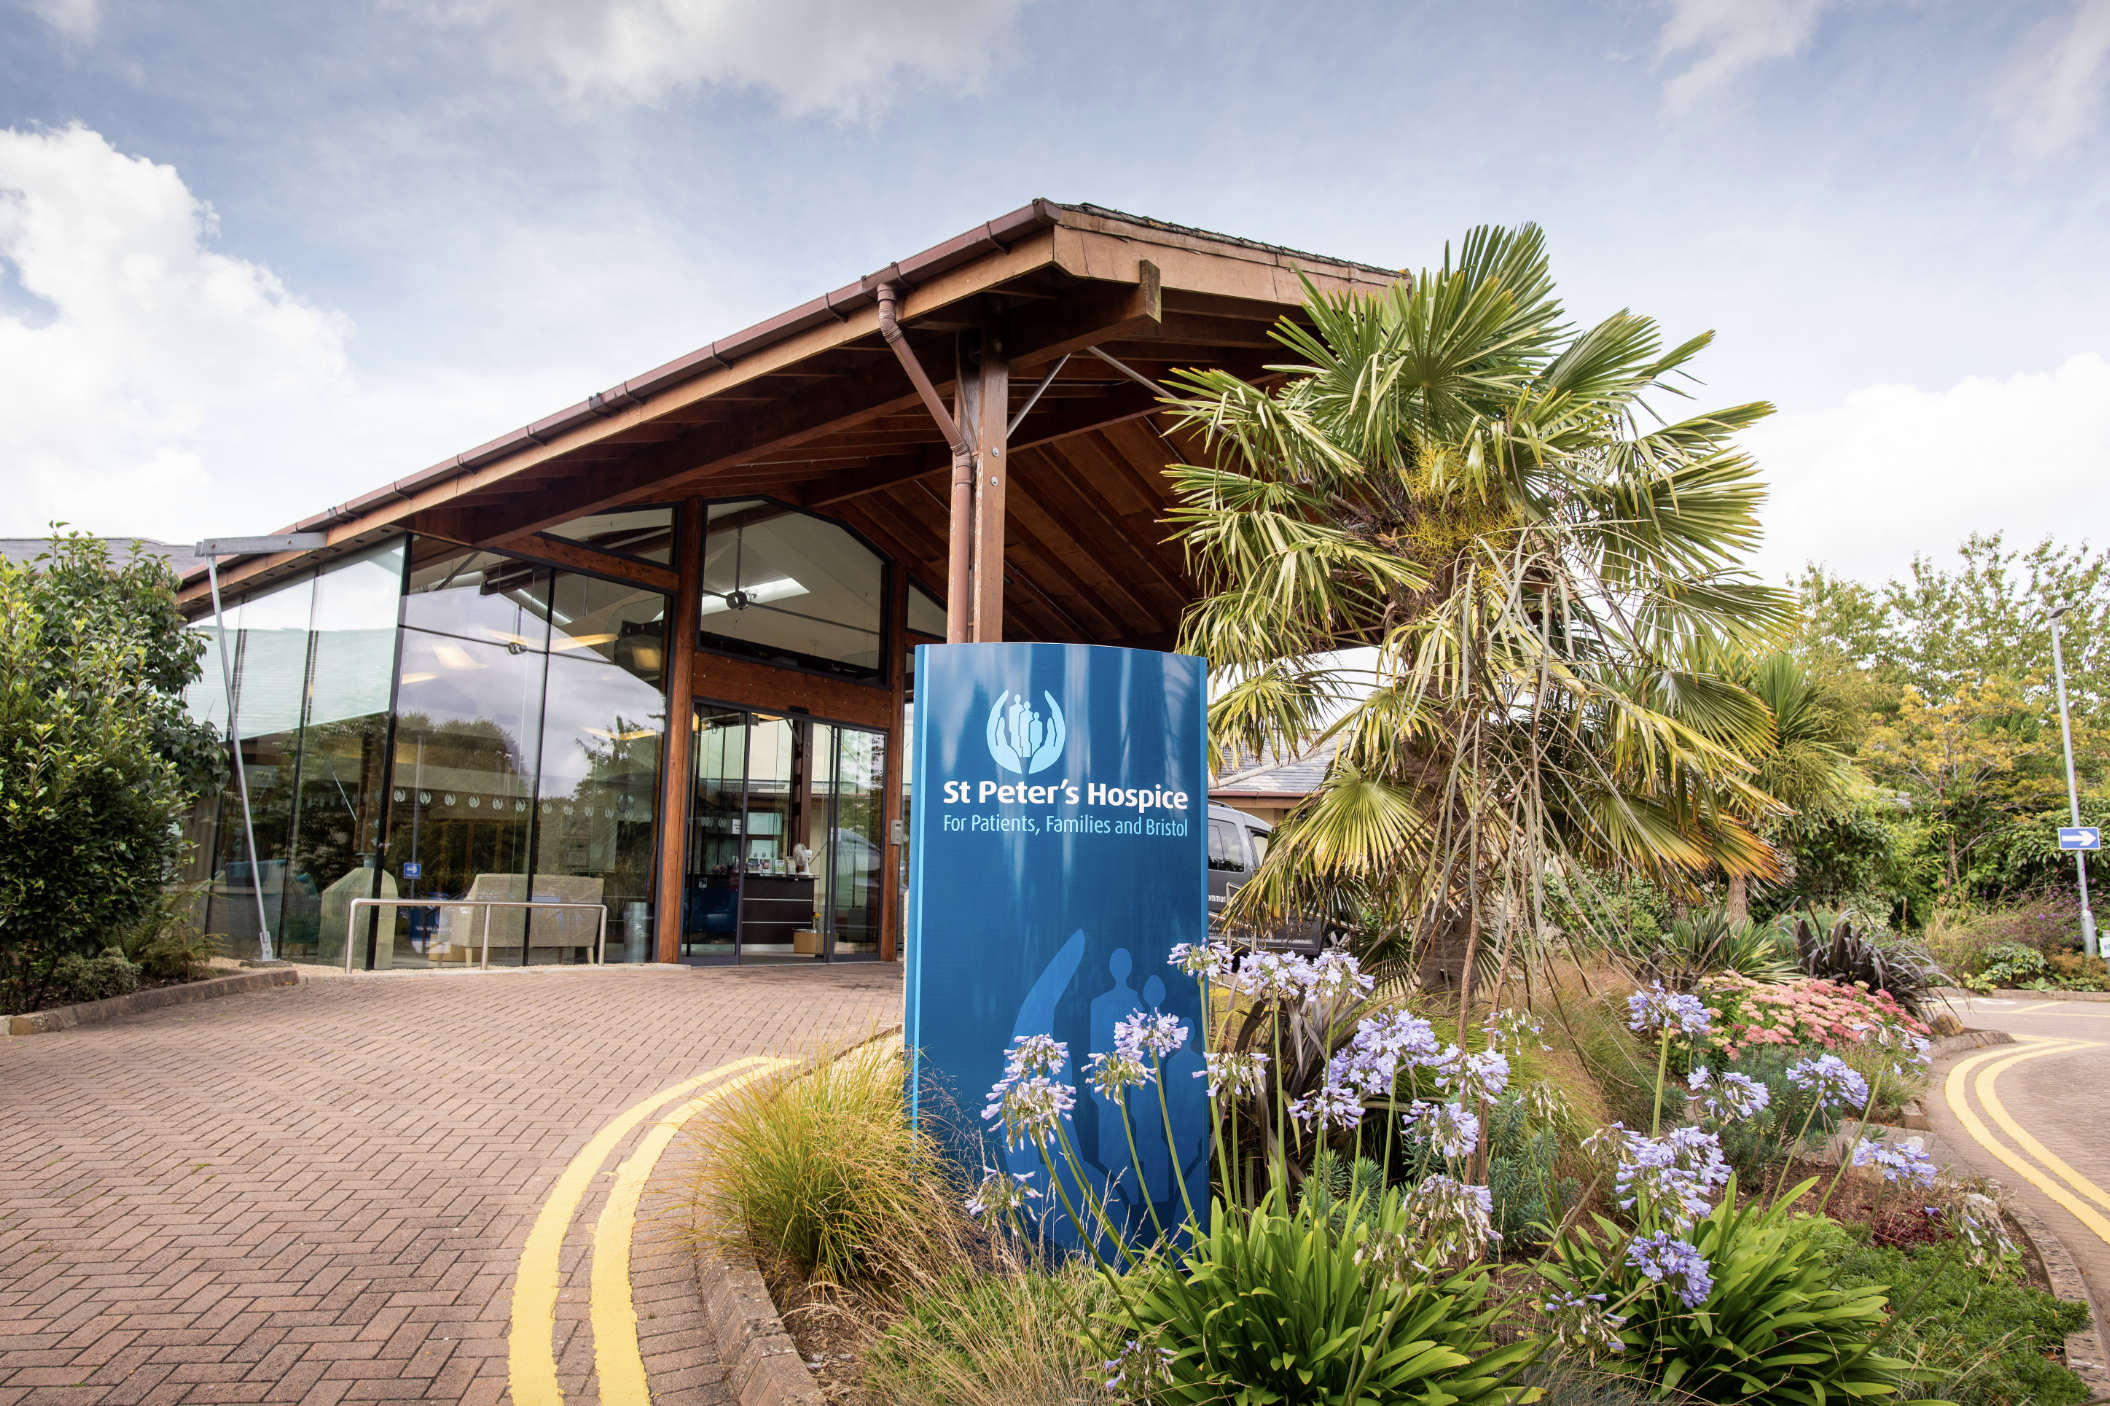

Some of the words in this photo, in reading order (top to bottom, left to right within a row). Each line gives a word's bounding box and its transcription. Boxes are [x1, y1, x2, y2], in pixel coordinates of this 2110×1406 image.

[943, 780, 971, 804] St
[979, 779, 1080, 805] Peter’s
[1088, 782, 1189, 814] Hospice
[943, 814, 967, 832] For
[971, 813, 1041, 836] Patients,
[1046, 814, 1111, 834] Families
[1114, 816, 1142, 835] and
[1146, 818, 1188, 837] Bristol
